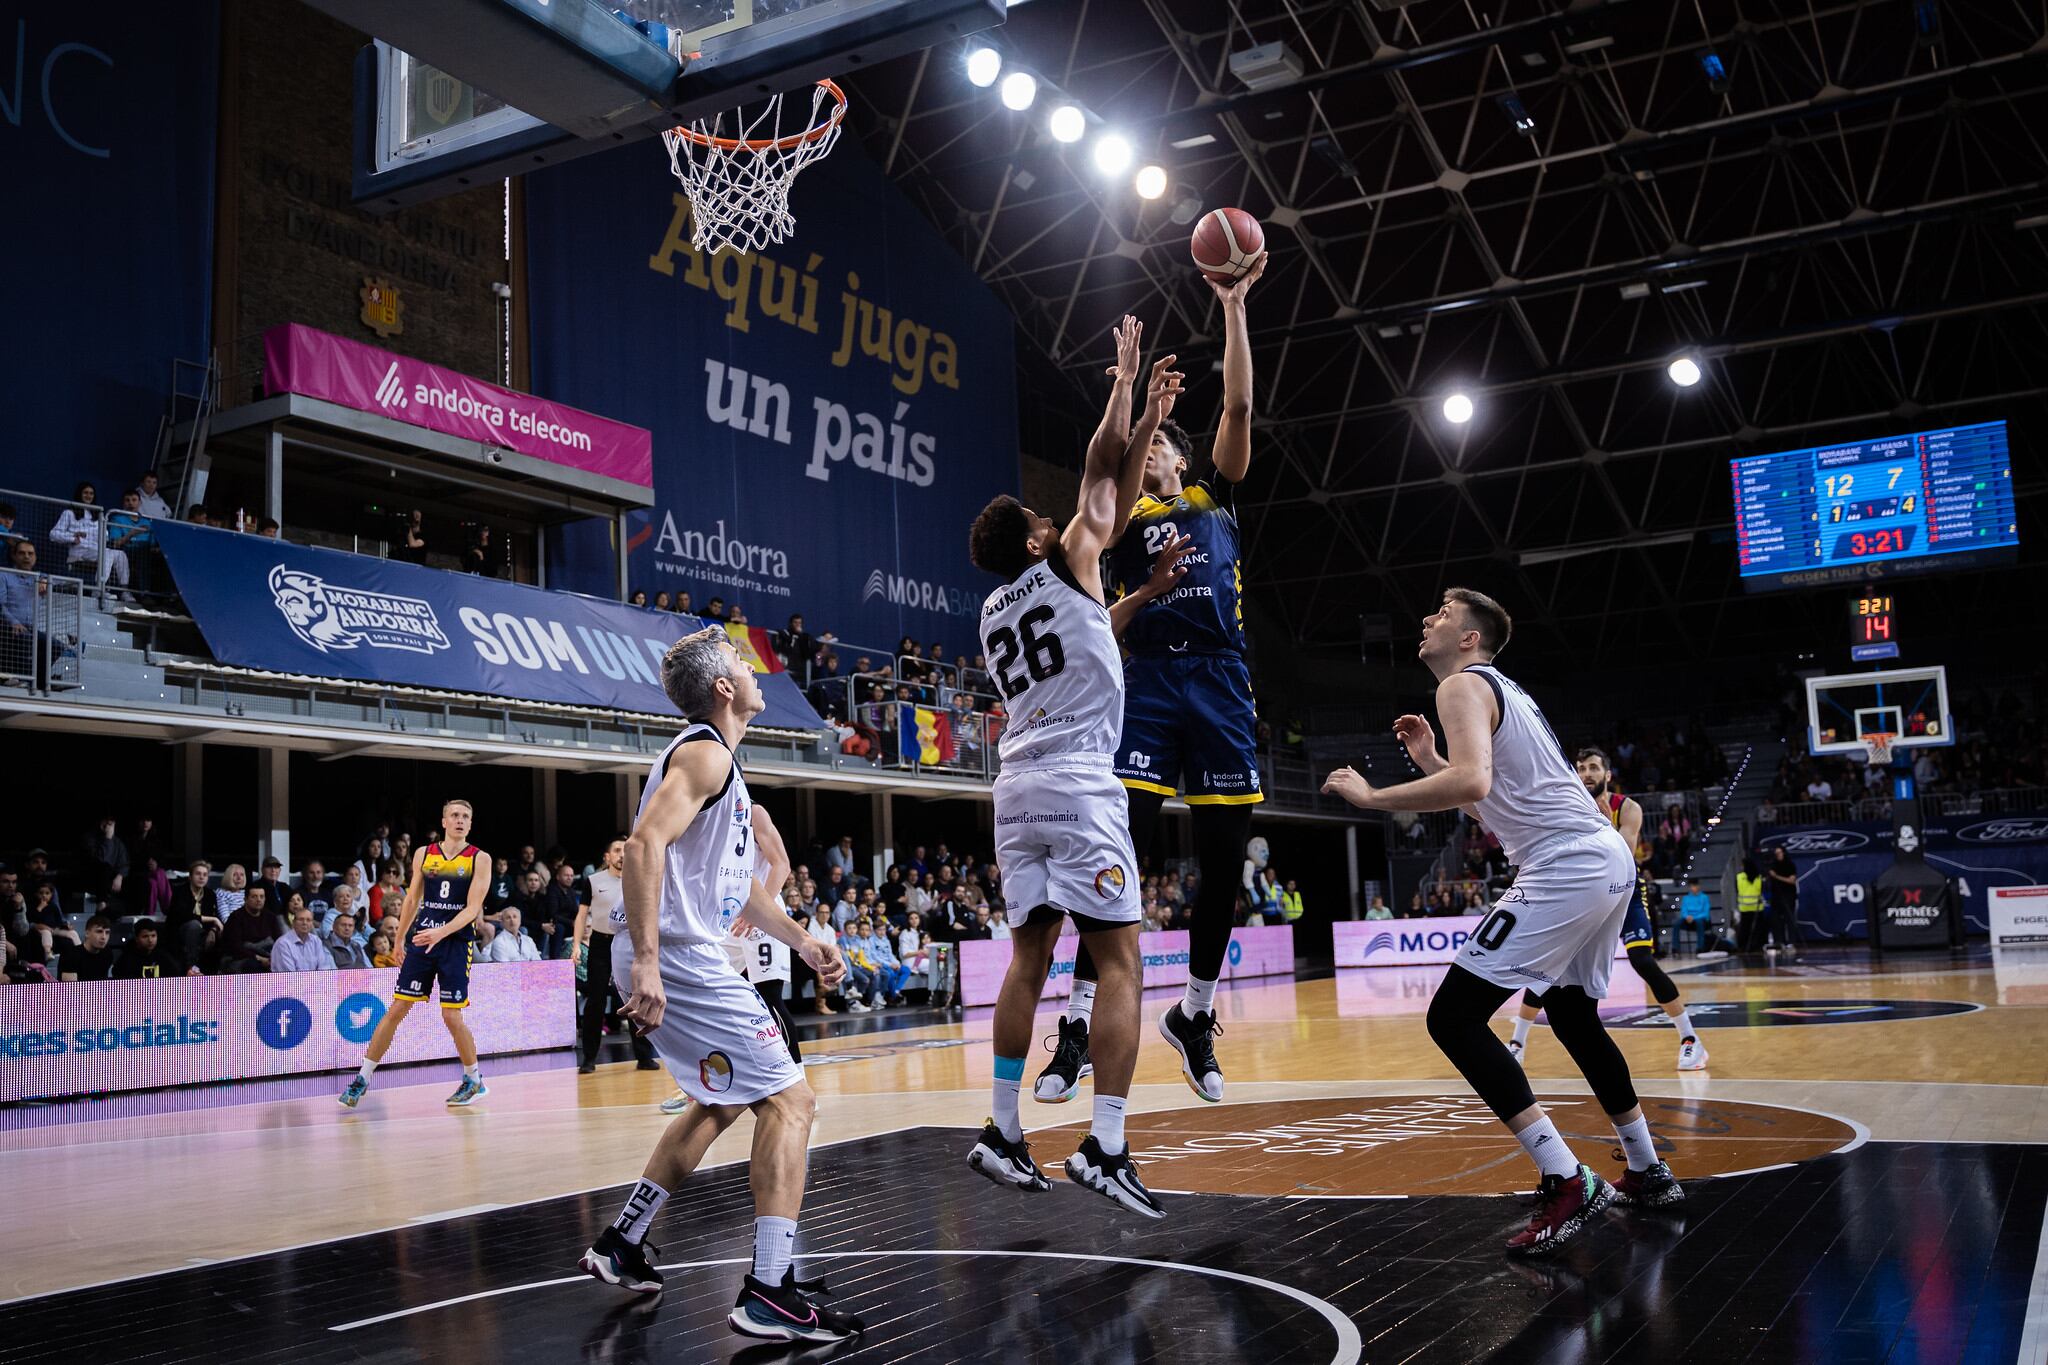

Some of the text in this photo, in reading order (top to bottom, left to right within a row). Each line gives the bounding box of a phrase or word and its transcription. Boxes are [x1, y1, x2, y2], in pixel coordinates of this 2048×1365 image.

[649, 191, 961, 395] Aquí juga
[415, 384, 592, 452] andorra telecom
[705, 358, 937, 487] un país
[1824, 473, 1854, 498] 12
[1887, 467, 1904, 490] 7
[1832, 506, 1843, 523] 1
[1902, 496, 1915, 512] 4
[654, 508, 790, 580] Andorra
[1143, 521, 1180, 556] 23
[1851, 528, 1904, 556] 3:21
[655, 560, 791, 597] www.visitandorra.com
[326, 590, 430, 618] MORABANC
[338, 606, 443, 641] ANDORRA
[1866, 615, 1889, 641] 14
[459, 606, 592, 674] SOM
[575, 625, 659, 686] UN
[986, 603, 1066, 702] 26
[1213, 772, 1244, 781] andorra
[1213, 780, 1246, 788] telecom
[1782, 833, 1849, 851] Ford
[440, 881, 454, 898] 8
[758, 943, 773, 967] 9
[74, 1014, 219, 1054] socials:
[619, 1182, 660, 1236] ELITE
